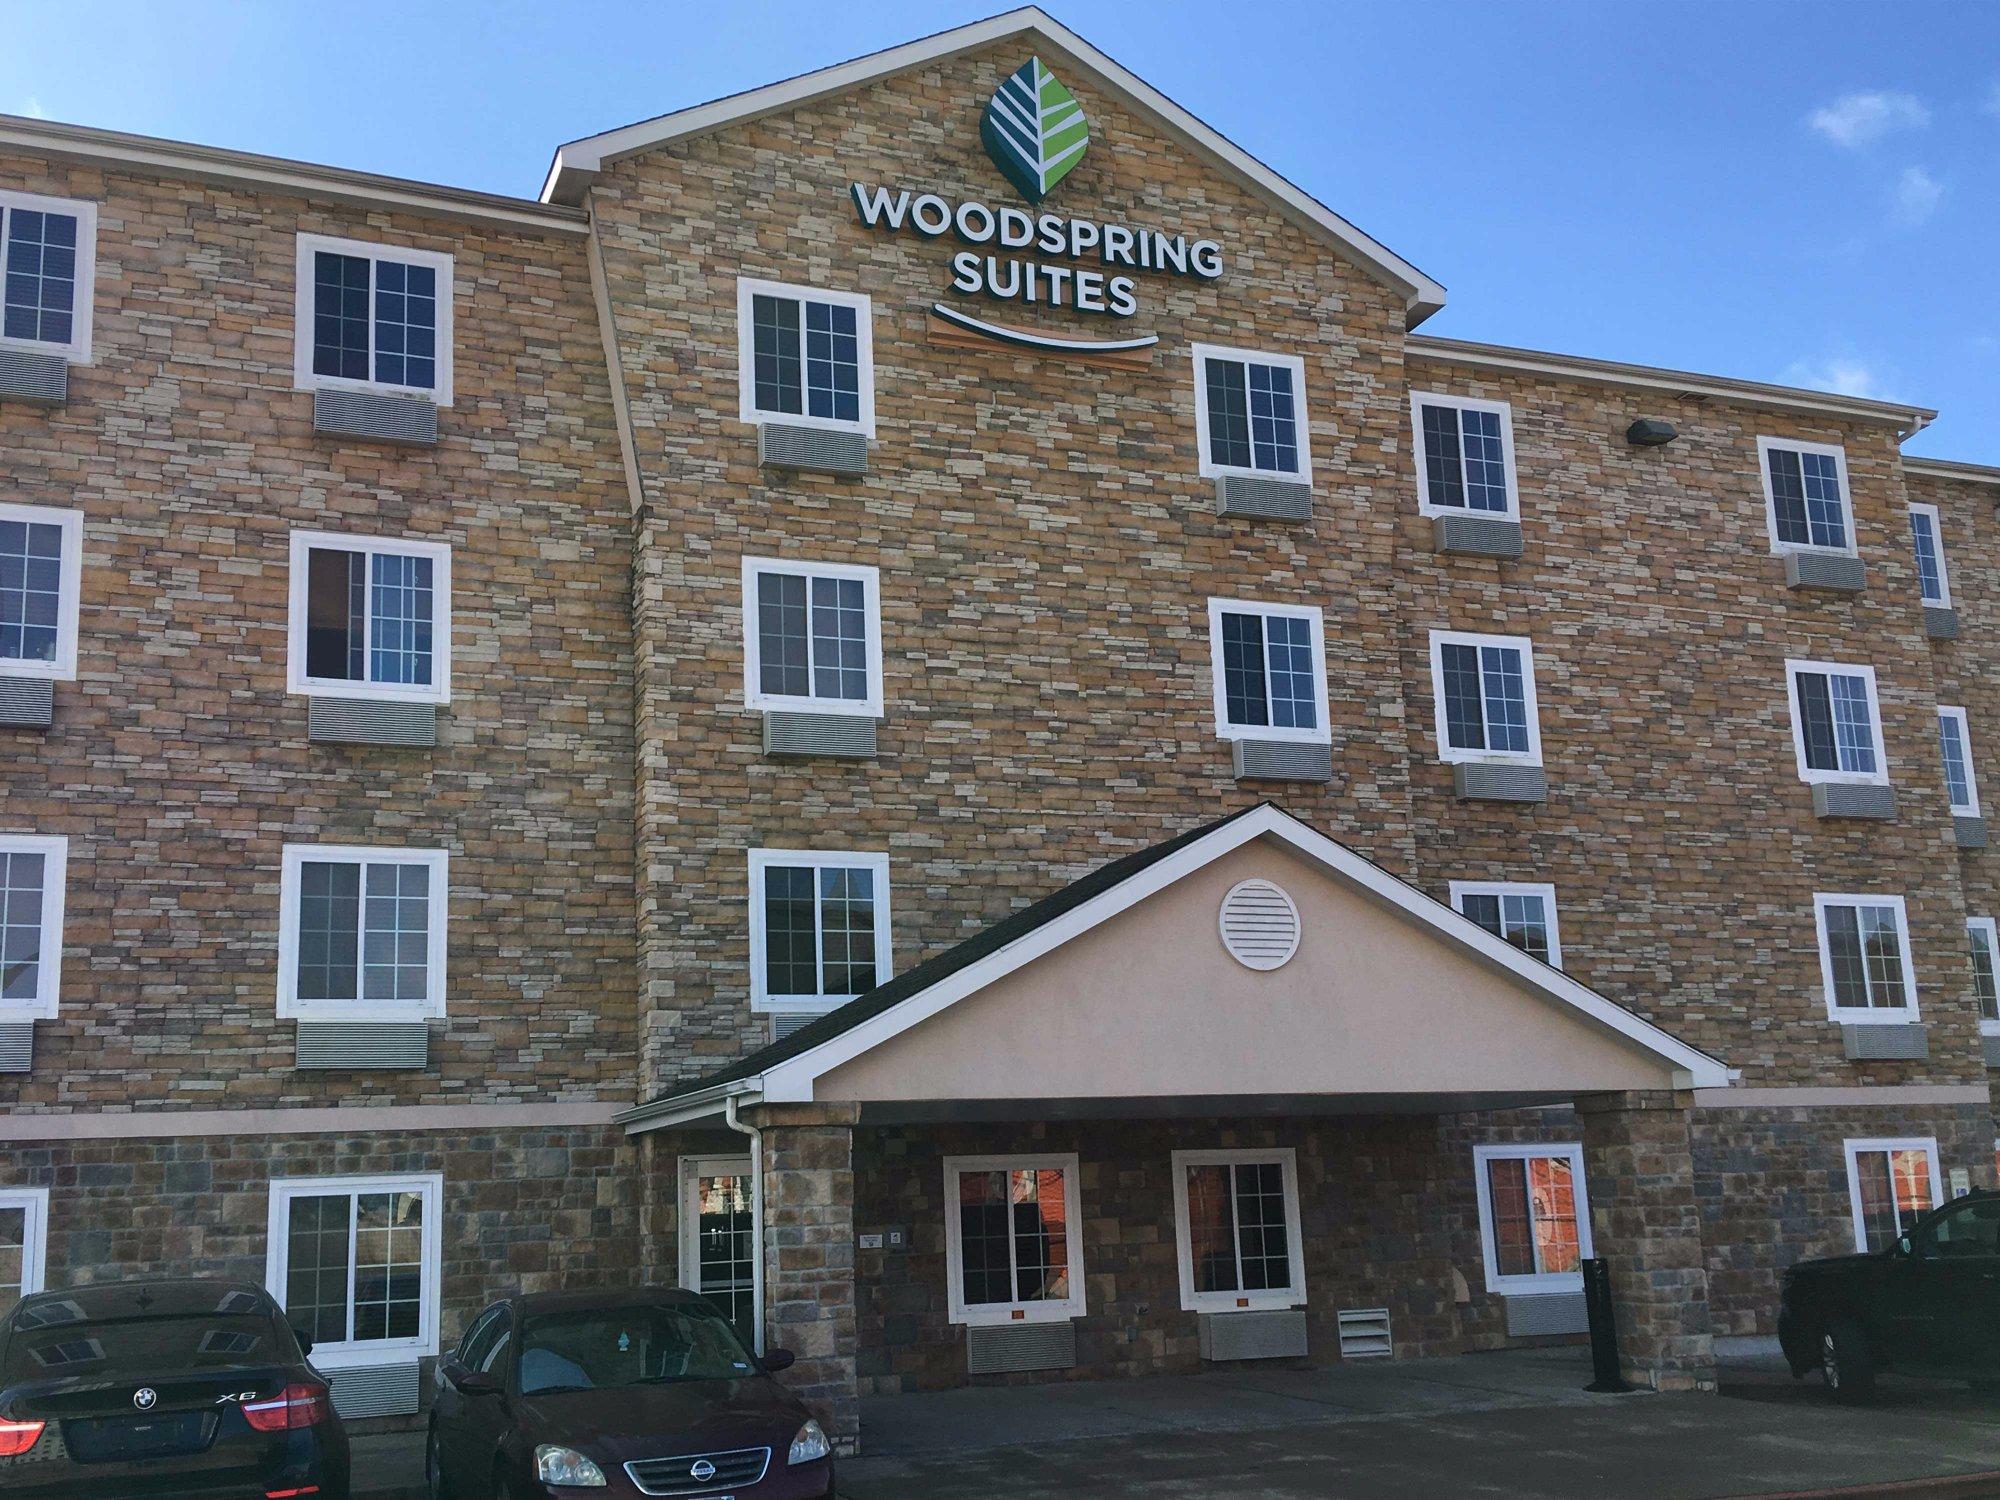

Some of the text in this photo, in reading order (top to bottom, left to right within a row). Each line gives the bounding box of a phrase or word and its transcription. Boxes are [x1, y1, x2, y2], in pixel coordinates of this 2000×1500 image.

[851, 182, 1223, 279] WOODSPRING
[952, 251, 1137, 317] SUITES
[215, 1391, 257, 1404] X6
